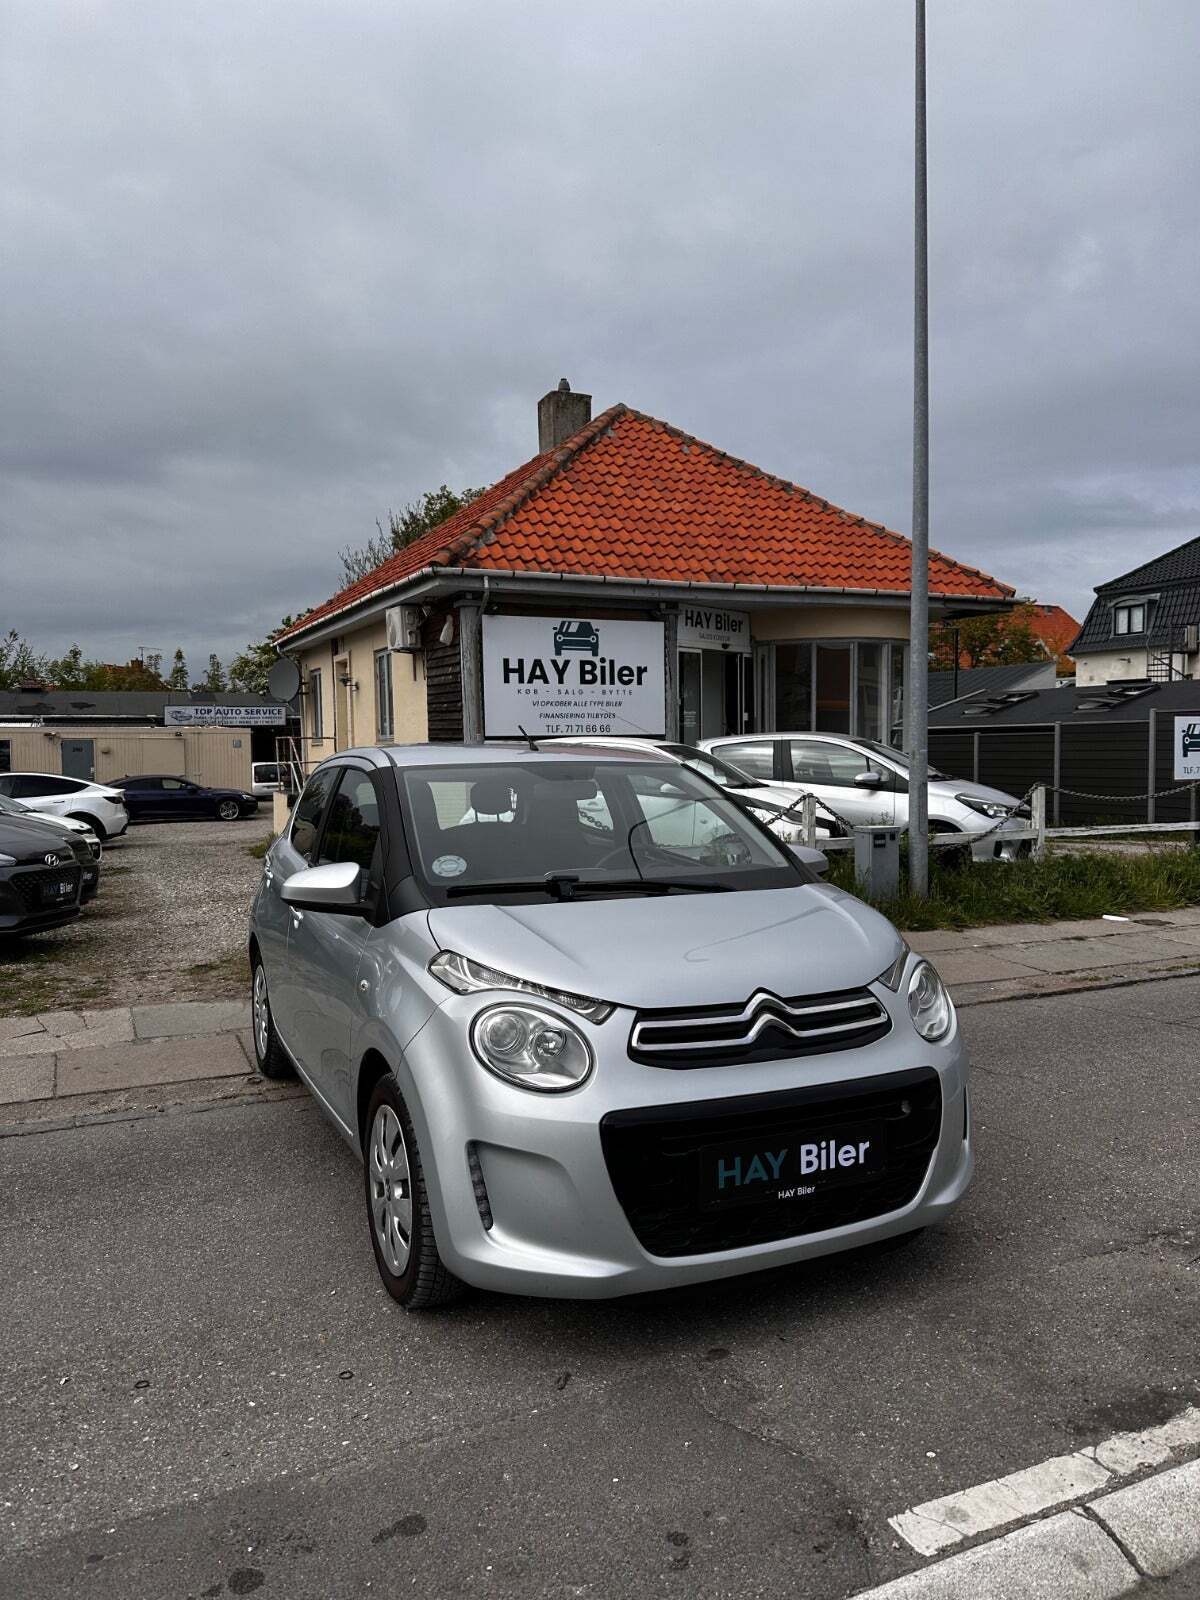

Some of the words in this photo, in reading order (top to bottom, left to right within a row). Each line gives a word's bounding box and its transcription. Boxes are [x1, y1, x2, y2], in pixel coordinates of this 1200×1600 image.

[684, 609, 712, 629] HAY
[715, 612, 744, 633] Biler
[502, 657, 571, 685] HAY
[579, 656, 648, 686] Biler
[573, 700, 588, 708] ALLE
[589, 700, 605, 708] TYPE
[605, 700, 623, 708] BILER
[545, 724, 563, 734] TLF.
[565, 724, 574, 733] 71
[575, 724, 584, 733] 71
[585, 725, 597, 733] 66
[599, 725, 611, 733] 66
[717, 1149, 788, 1189] HAY
[800, 1139, 870, 1175] Biler
[778, 1188, 796, 1200] HAY
[796, 1184, 816, 1197] Biler
